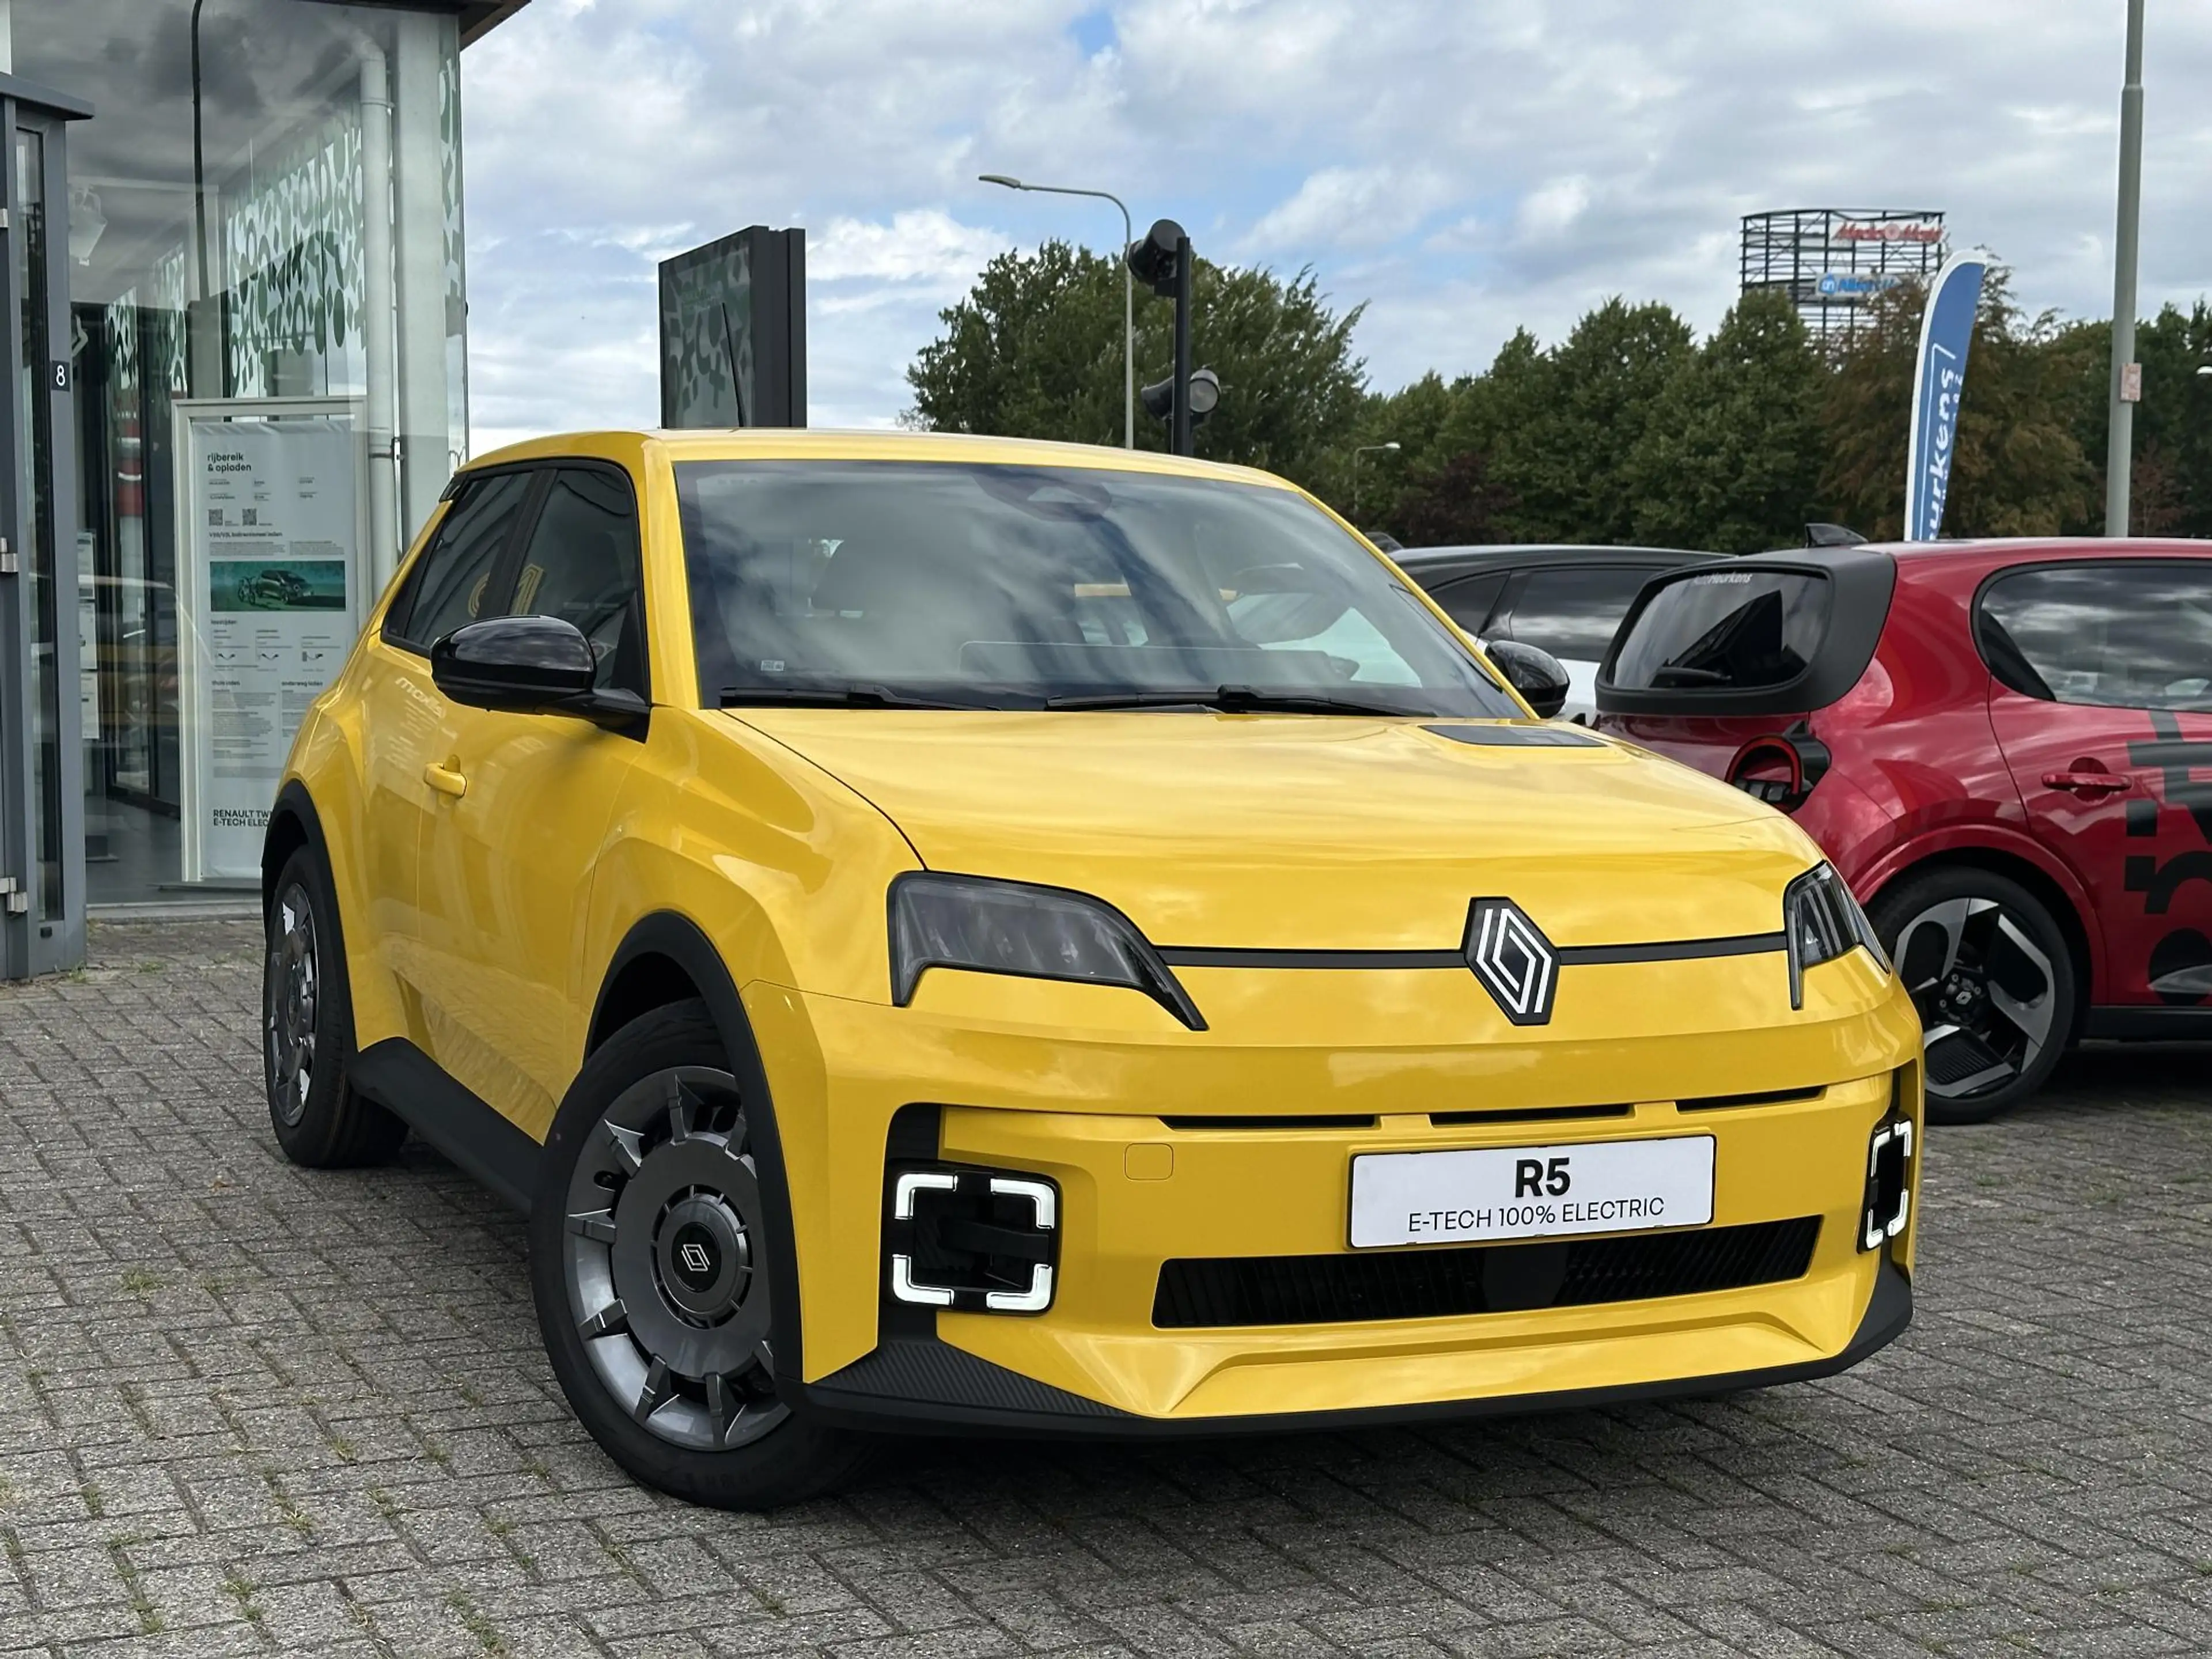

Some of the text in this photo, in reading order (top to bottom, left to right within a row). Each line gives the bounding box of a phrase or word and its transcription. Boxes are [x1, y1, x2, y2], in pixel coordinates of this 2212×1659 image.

[56, 364, 66, 387] 8
[207, 452, 244, 463] rijbereik
[207, 463, 214, 472] &
[213, 809, 273, 818] RENAULT TW
[214, 818, 246, 826] E-TECH
[1515, 1157, 1570, 1198] R5
[1408, 1197, 1665, 1232] E-TECH 100% ELECTRIC
